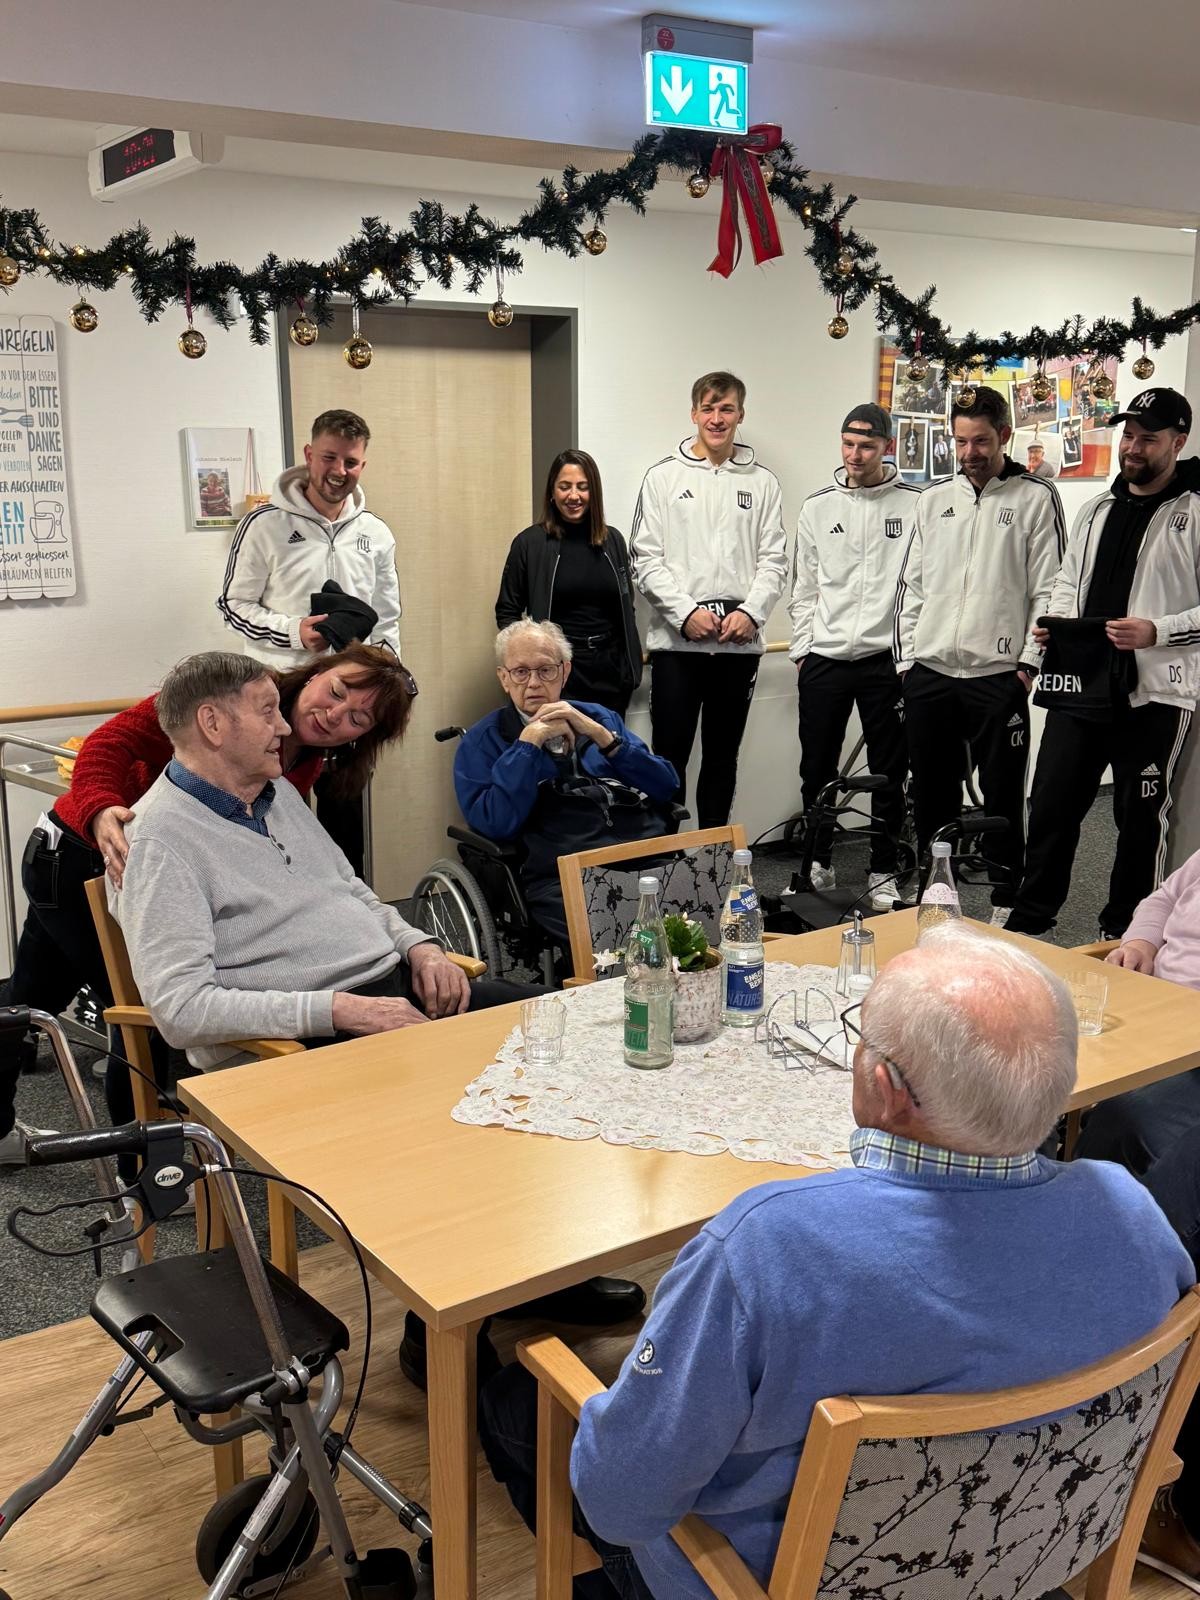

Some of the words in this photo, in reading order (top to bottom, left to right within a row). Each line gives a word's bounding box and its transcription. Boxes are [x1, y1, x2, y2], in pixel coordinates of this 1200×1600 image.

[39, 369, 56, 382] ESSEN
[29, 386, 58, 408] BITTE
[38, 412, 59, 428] UND
[28, 430, 61, 452] DANKE
[37, 455, 63, 472] SAGEN
[10, 480, 64, 493] AUSSCHALTEN
[44, 567, 73, 579] HELFEN
[997, 637, 1012, 654] CK
[1169, 665, 1182, 683] DS
[1010, 730, 1024, 746] CK
[1141, 780, 1159, 798] DS
[157, 1172, 181, 1183] drive
